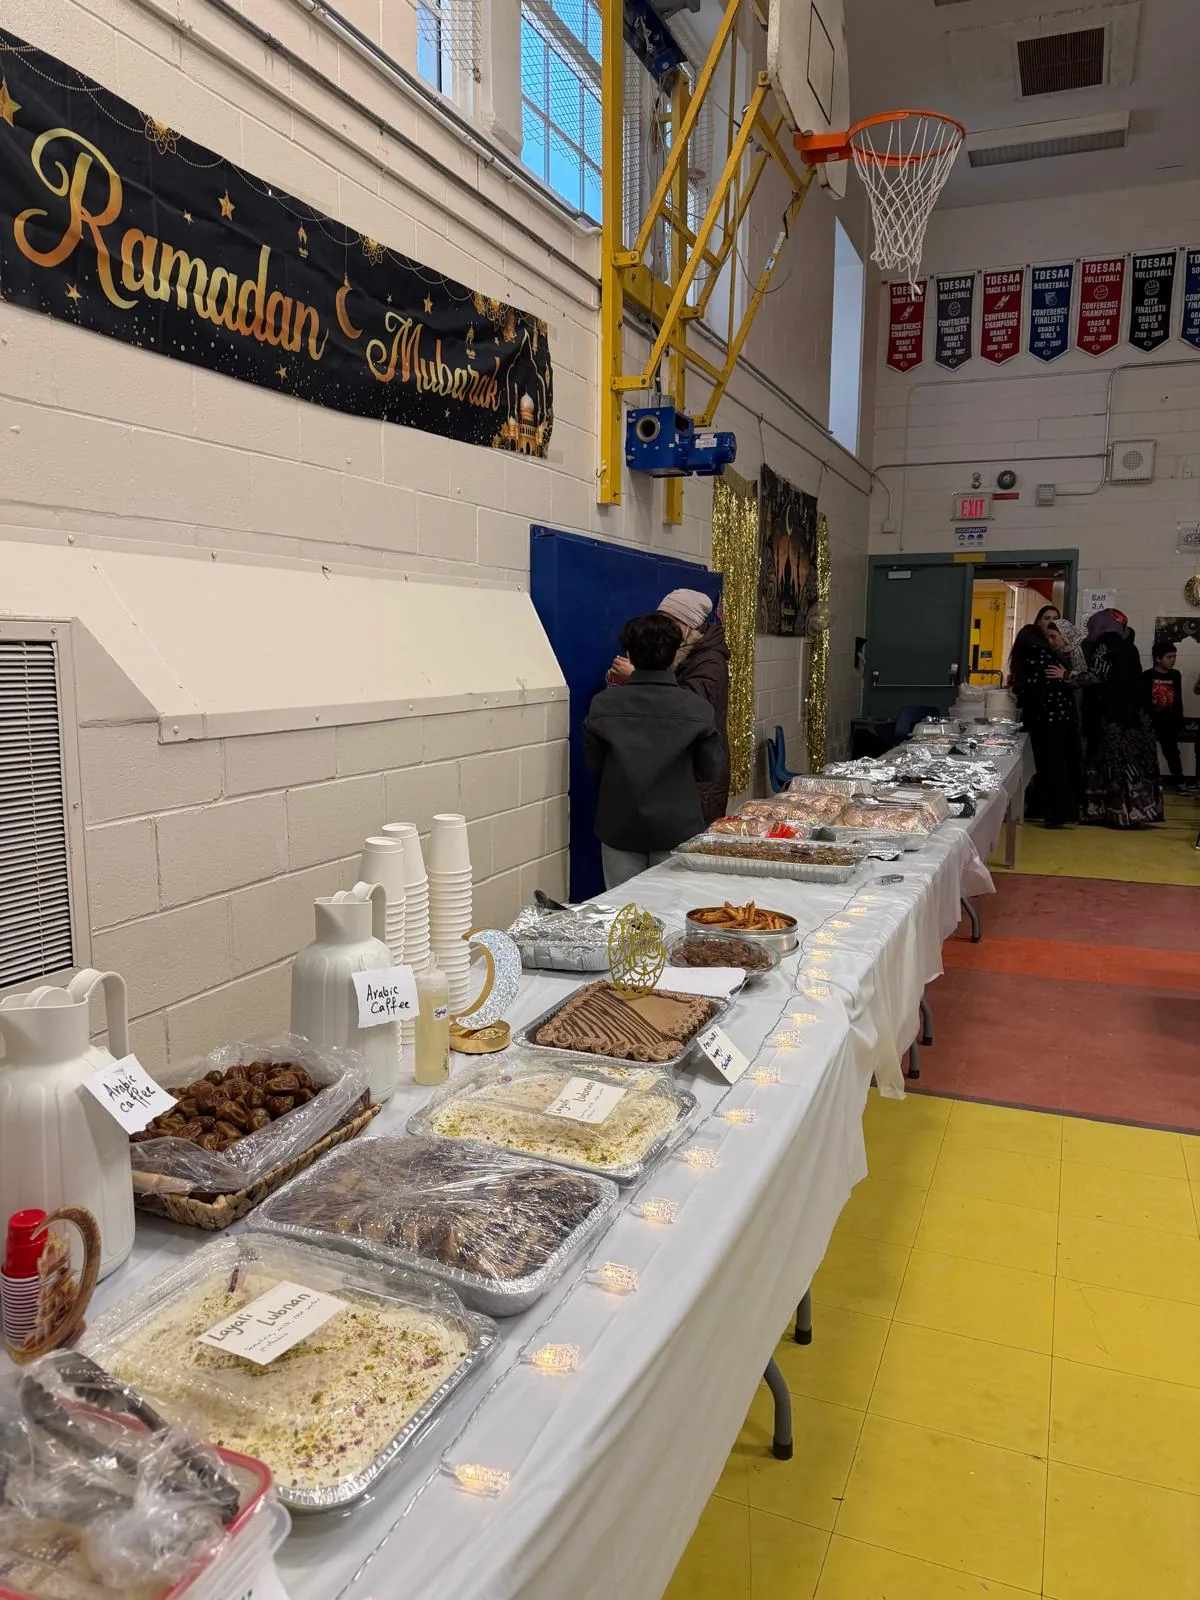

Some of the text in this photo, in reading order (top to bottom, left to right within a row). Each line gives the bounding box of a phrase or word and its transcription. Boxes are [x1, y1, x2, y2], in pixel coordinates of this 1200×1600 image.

[1136, 256, 1172, 268] TDESAA
[13, 127, 501, 412] Ramadan Mubarak
[1084, 262, 1121, 274] TDESAA
[1135, 268, 1172, 278] VOLLEYBALL
[986, 274, 1020, 285] TDESAA
[1035, 269, 1069, 280] TDESAA
[1084, 275, 1120, 283] VOLLEYBALL
[939, 279, 971, 290] TDESAA
[1034, 281, 1069, 290] BASKETBALL
[892, 285, 923, 295] TDESA
[939, 291, 970, 300] VOLLEYBALL
[1082, 300, 1119, 310] CONFERENCE
[1135, 305, 1167, 314] FINALISTS
[984, 311, 1019, 321] CONFERENCE
[1032, 307, 1068, 317] CONFERENCE
[1082, 308, 1117, 317] CHAMPIONS
[939, 316, 970, 327] CONFERENCE
[985, 319, 1017, 329] CHAMPIONS
[1035, 315, 1064, 324] FINALISTS
[891, 321, 922, 330] CONFERENCE
[941, 325, 967, 334] FINALISTS
[961, 500, 984, 516] EXIT
[366, 984, 399, 1002] Arabic
[102, 1075, 137, 1101] Arabic
[256, 1293, 311, 1326] Lubnan
[207, 1313, 253, 1342] Layali
